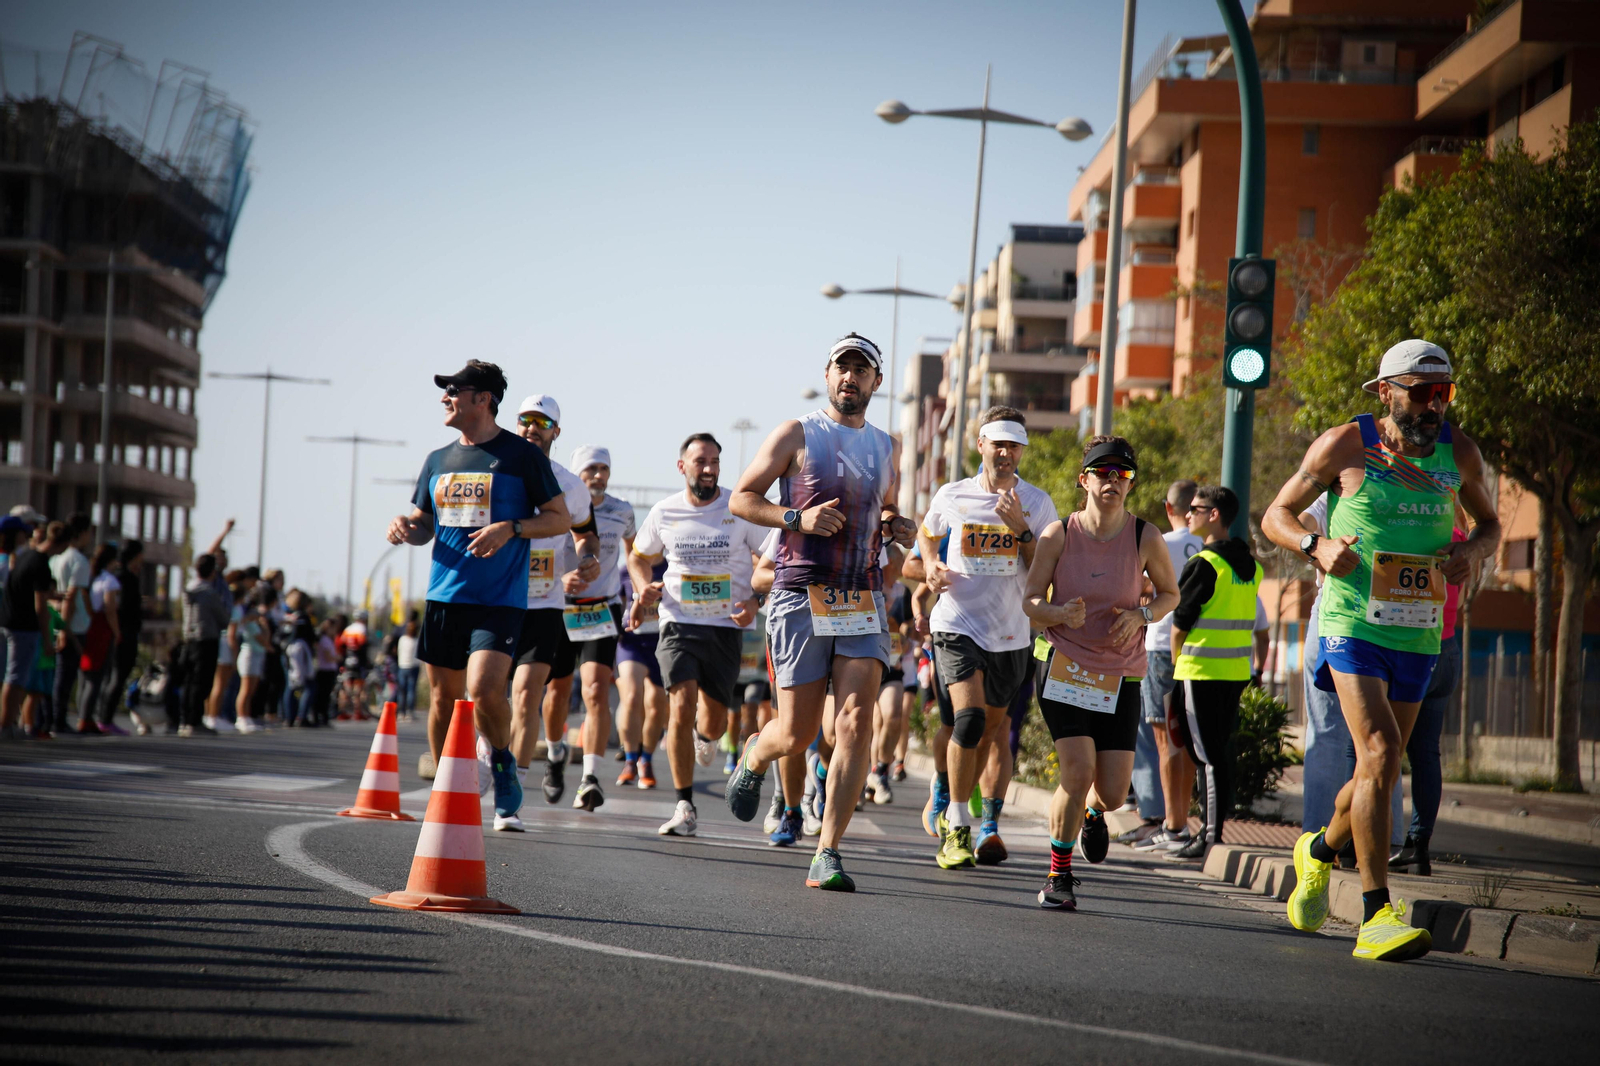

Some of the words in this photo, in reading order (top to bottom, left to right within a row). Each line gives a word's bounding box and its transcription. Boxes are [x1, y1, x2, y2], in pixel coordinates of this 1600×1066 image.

[442, 482, 485, 498] 1266
[674, 541, 705, 549] Almería
[707, 540, 730, 548] 2024
[967, 532, 1013, 549] 1728
[1398, 567, 1430, 590] 66
[691, 582, 721, 595] 565
[1390, 588, 1412, 596] PEDRO
[823, 586, 862, 605] 314
[574, 612, 602, 623] 798
[1072, 673, 1096, 685] BEGOÑA
